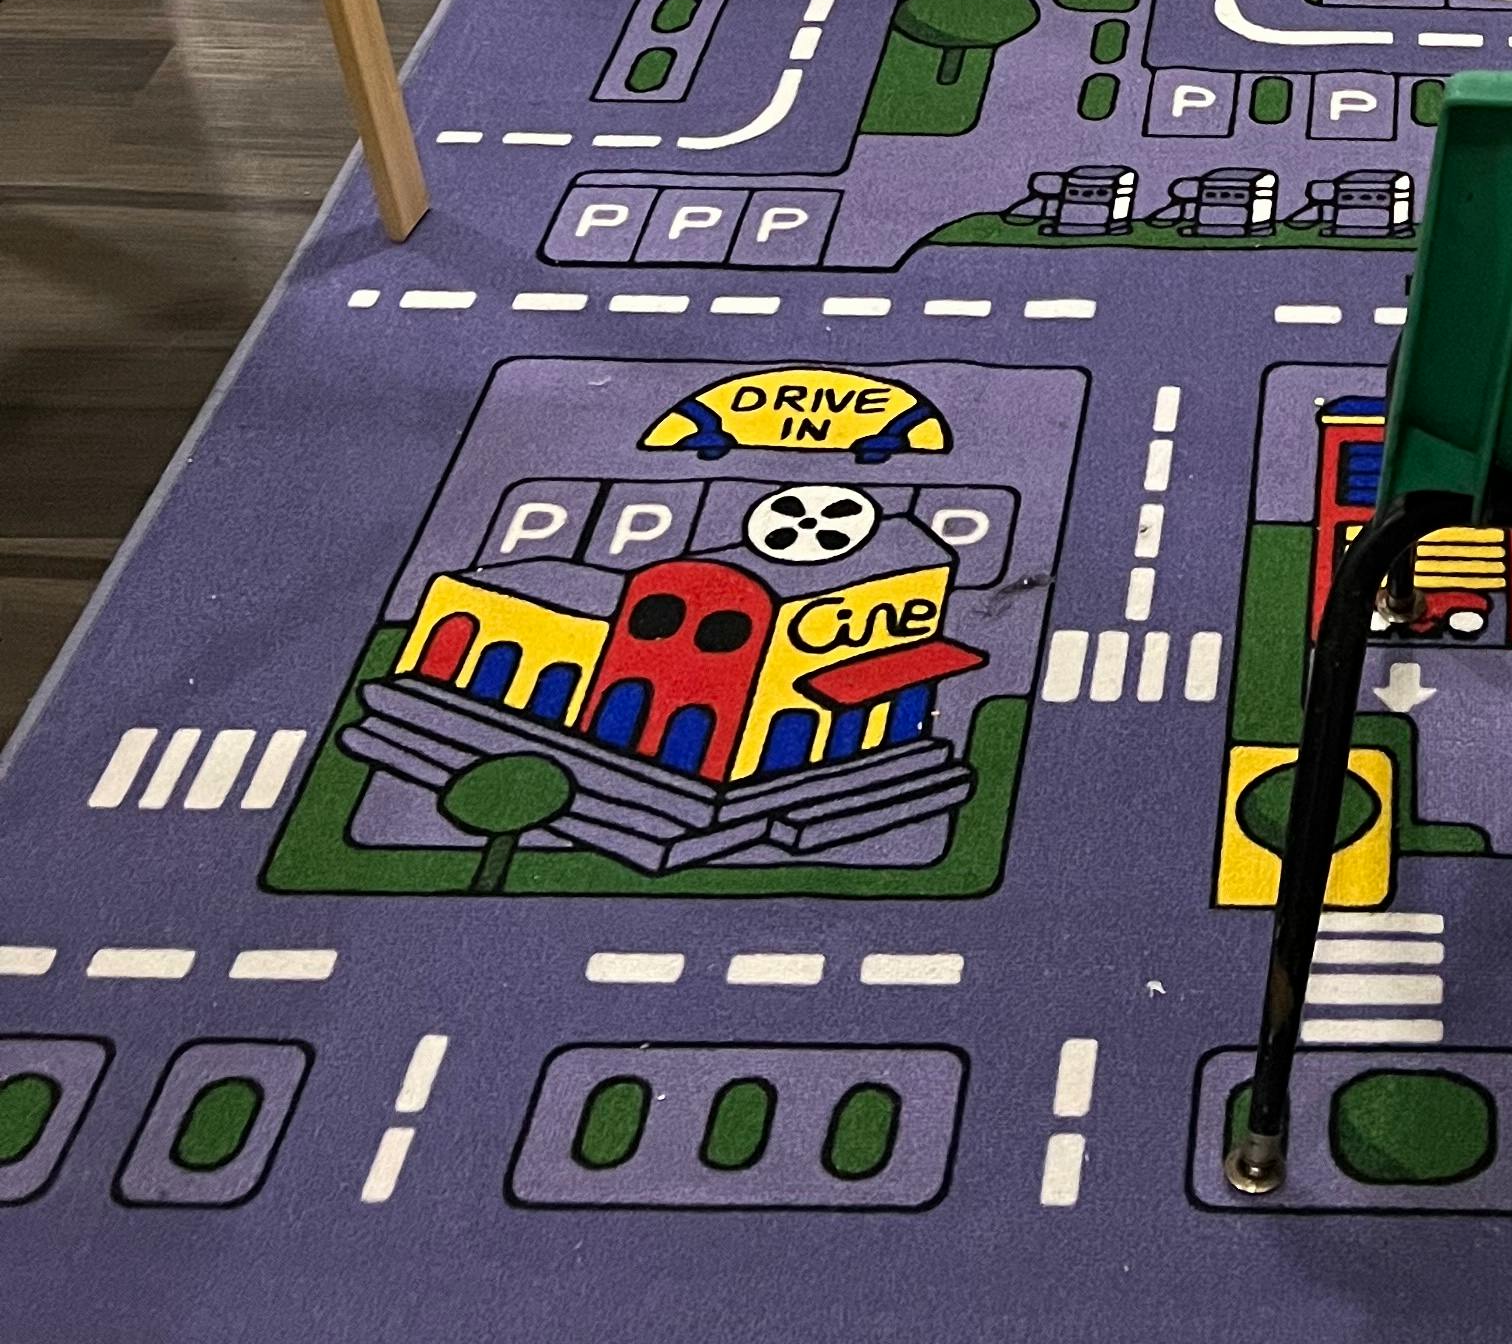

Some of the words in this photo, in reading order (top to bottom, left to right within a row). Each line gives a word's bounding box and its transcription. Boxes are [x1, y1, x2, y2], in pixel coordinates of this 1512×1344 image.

[1172, 83, 1217, 120] P
[1329, 89, 1378, 122] P
[574, 203, 631, 239] P
[667, 204, 725, 241] P
[756, 205, 811, 243] P
[729, 384, 891, 416] DRIVE
[779, 415, 832, 443] IN
[500, 502, 571, 555] P
[609, 503, 674, 556] P
[787, 597, 943, 655] Cine
